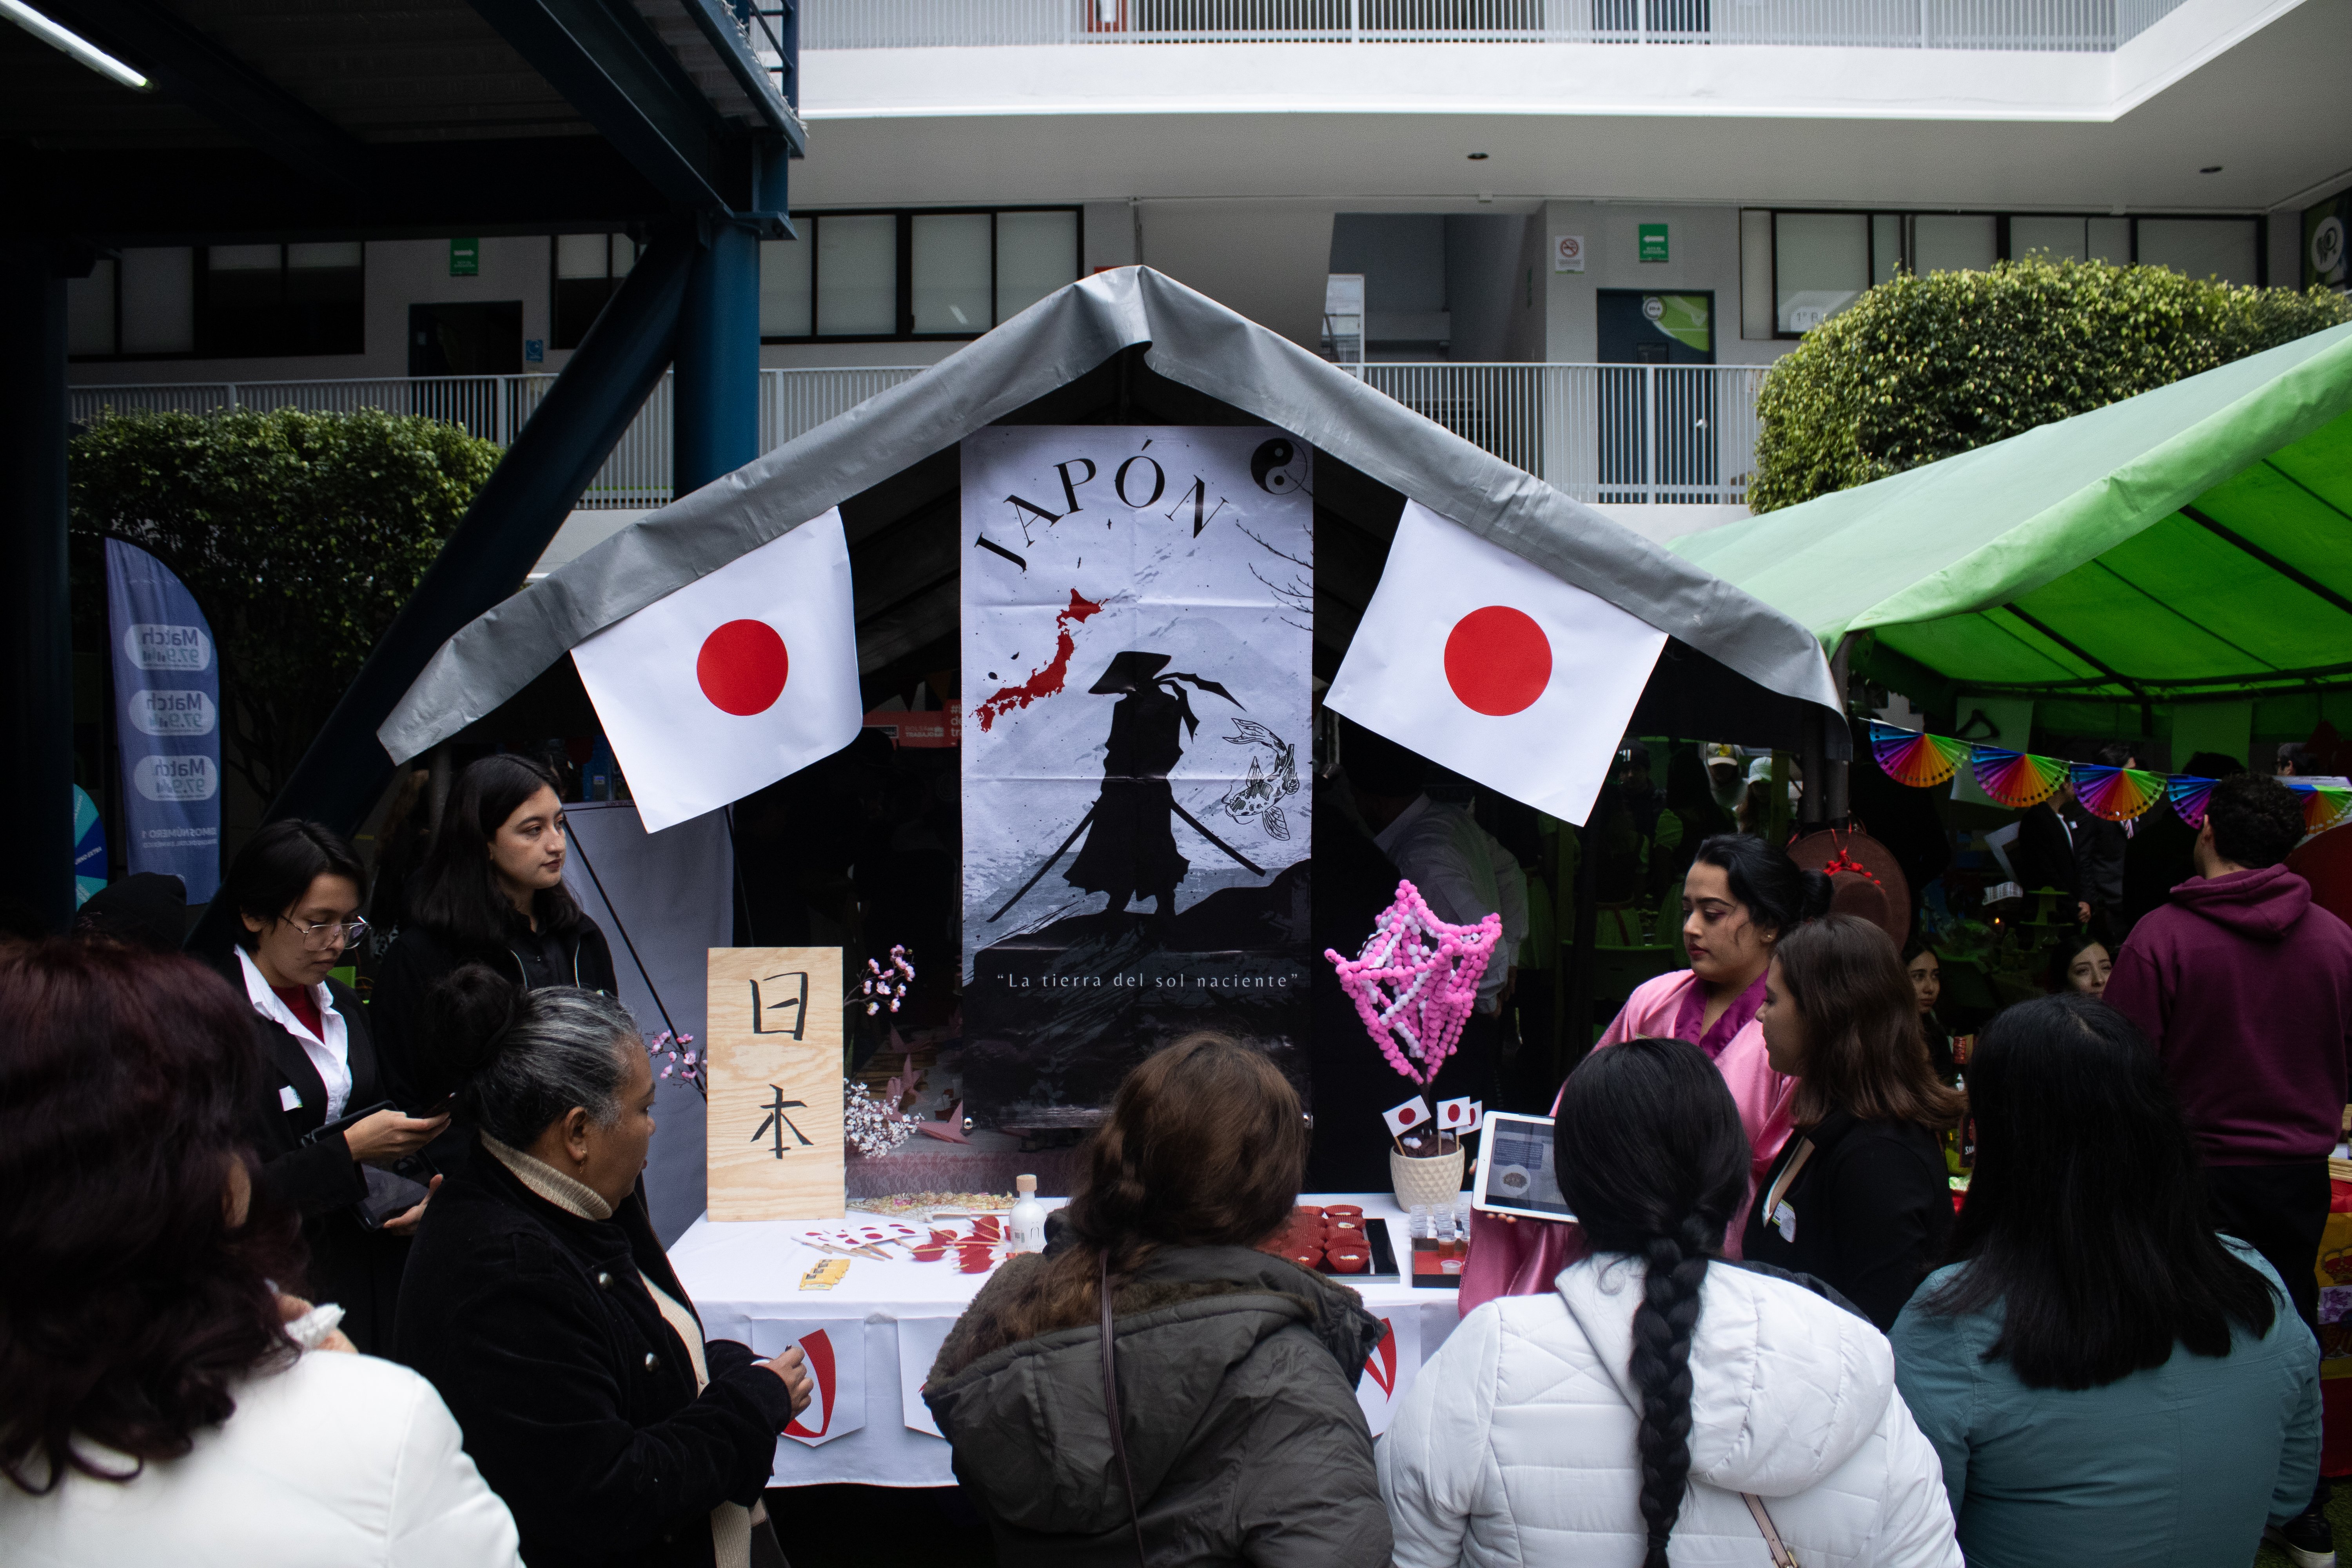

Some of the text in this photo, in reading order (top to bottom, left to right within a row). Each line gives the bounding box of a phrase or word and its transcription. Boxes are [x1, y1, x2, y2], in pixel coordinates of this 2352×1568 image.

[974, 439, 1229, 573] JAPÓN
[1042, 973, 1102, 987] tierra
[1113, 973, 1143, 987] del
[1155, 973, 1184, 987] sol
[749, 971, 814, 1160] 日本
